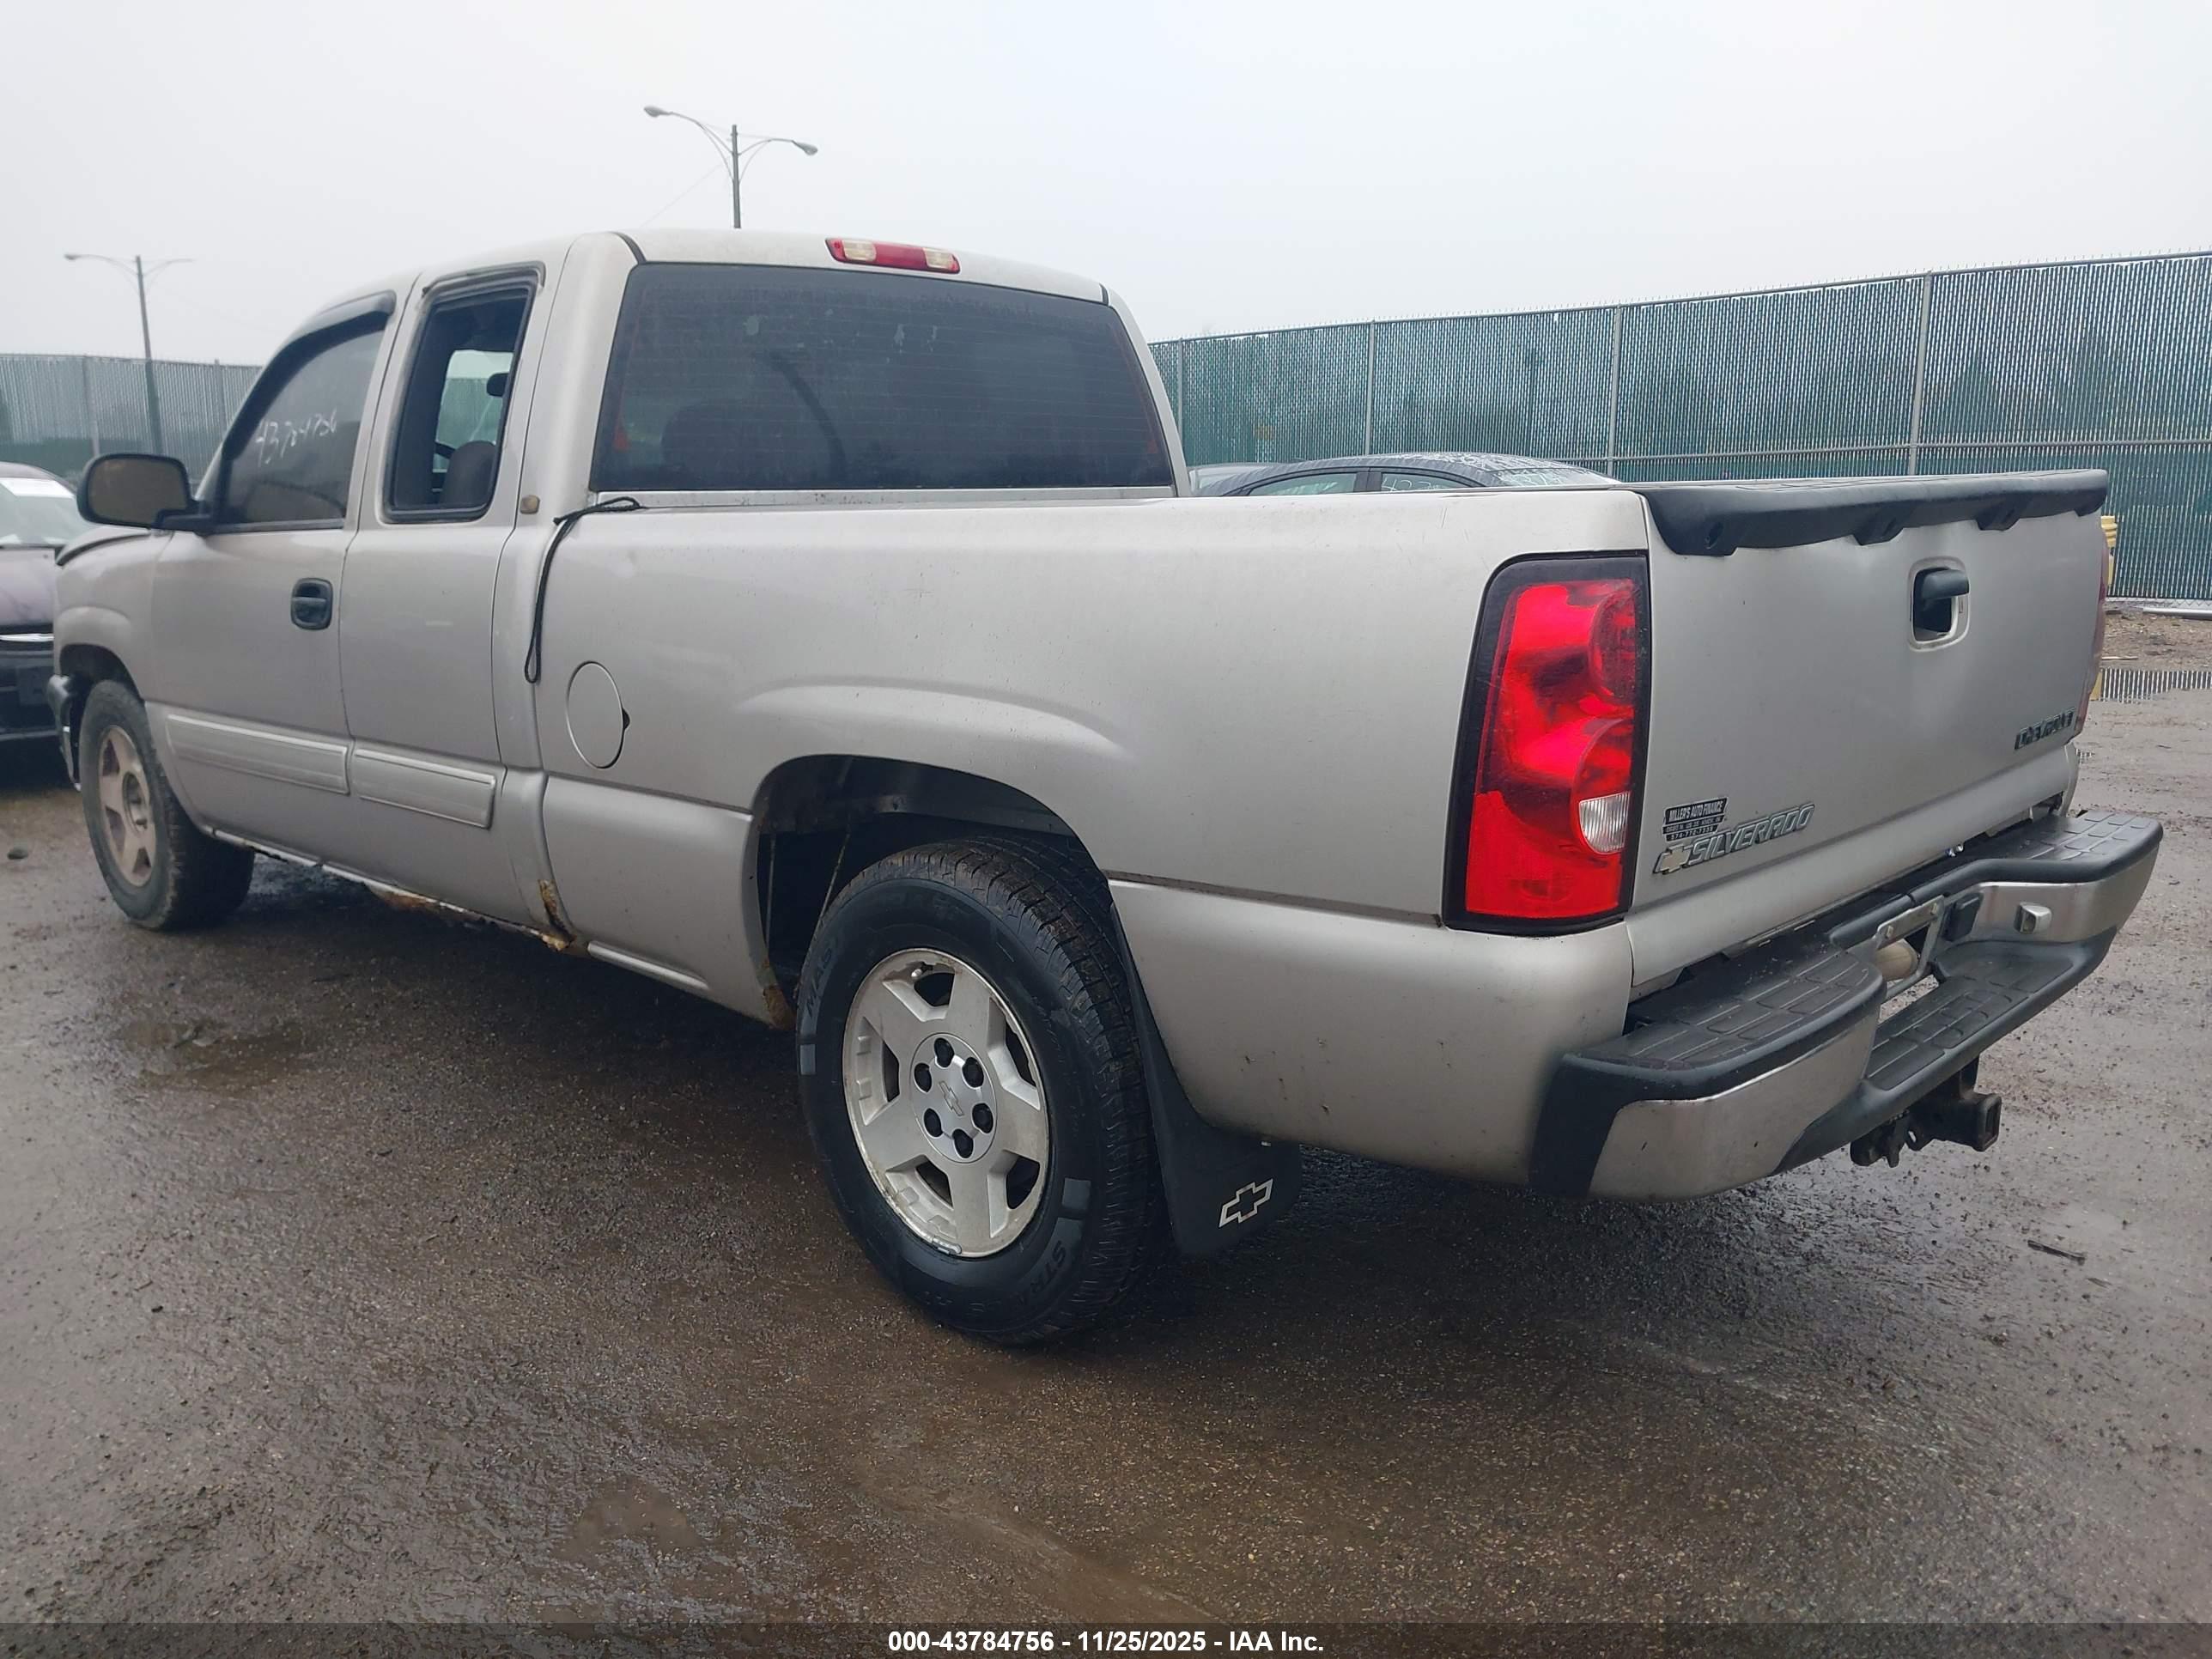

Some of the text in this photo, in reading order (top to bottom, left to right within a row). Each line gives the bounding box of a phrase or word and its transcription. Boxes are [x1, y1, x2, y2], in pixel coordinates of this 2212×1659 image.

[1690, 804, 1705, 817] AUTO
[1703, 800, 1723, 815] FINANCE
[1688, 803, 1815, 866] SILVERADO
